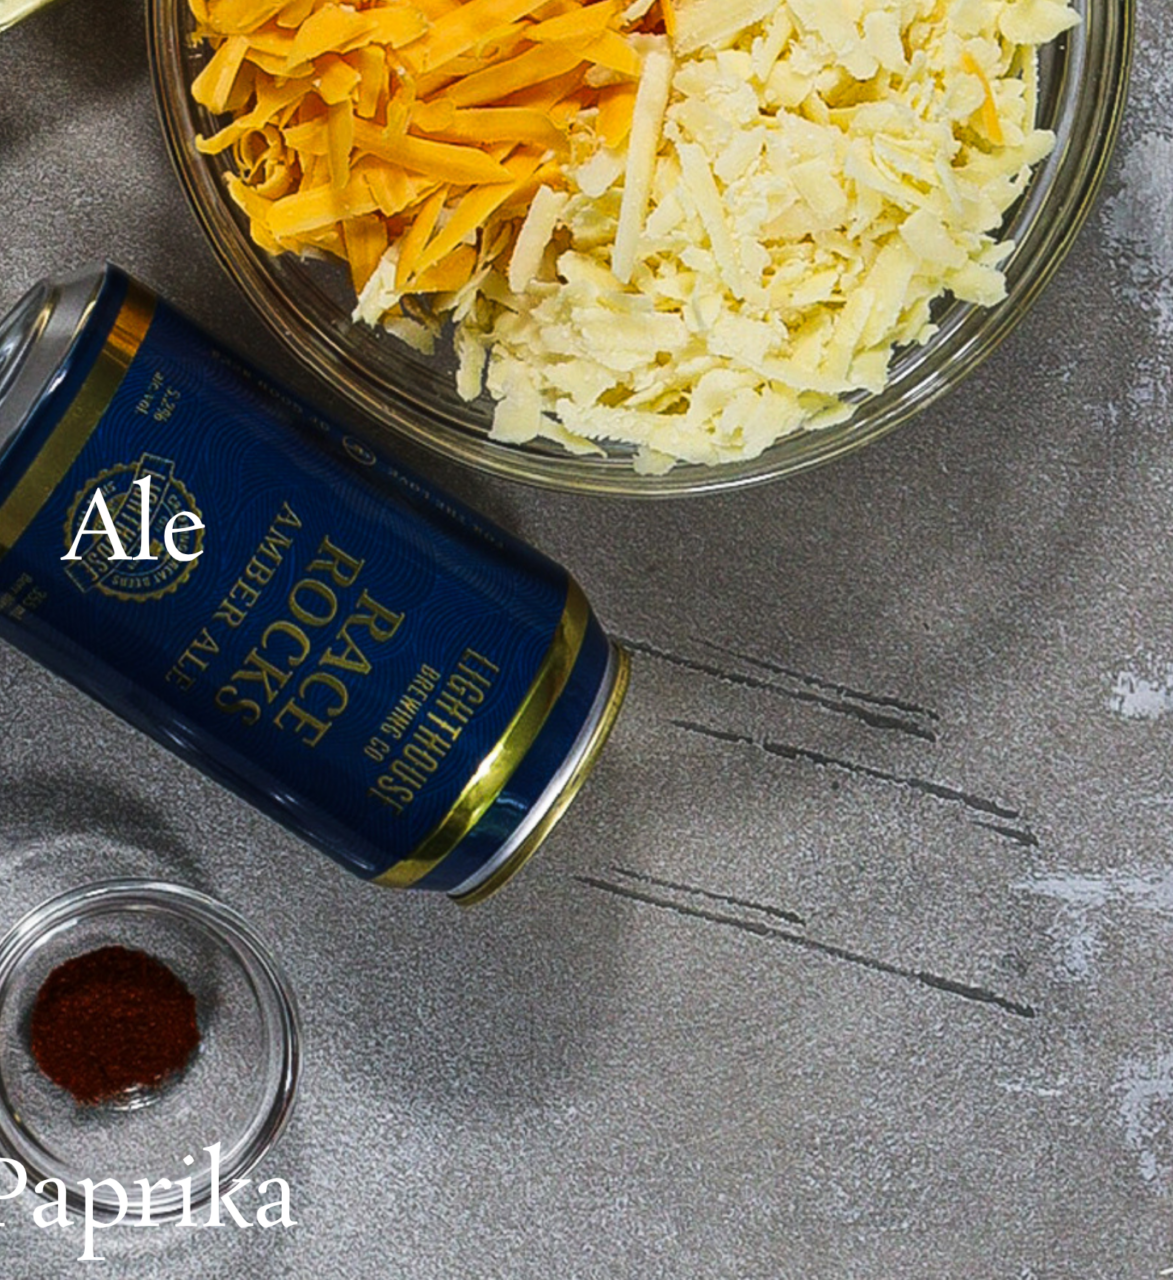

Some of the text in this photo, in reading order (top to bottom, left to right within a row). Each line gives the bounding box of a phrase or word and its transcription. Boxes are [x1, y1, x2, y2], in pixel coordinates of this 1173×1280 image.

[165, 501, 302, 691] AMBER ALE
[215, 534, 365, 725] ROCKS
[274, 588, 405, 750] RACE
[364, 663, 441, 761] BREWING CO
[368, 648, 500, 814] LIGHTHOUSE
